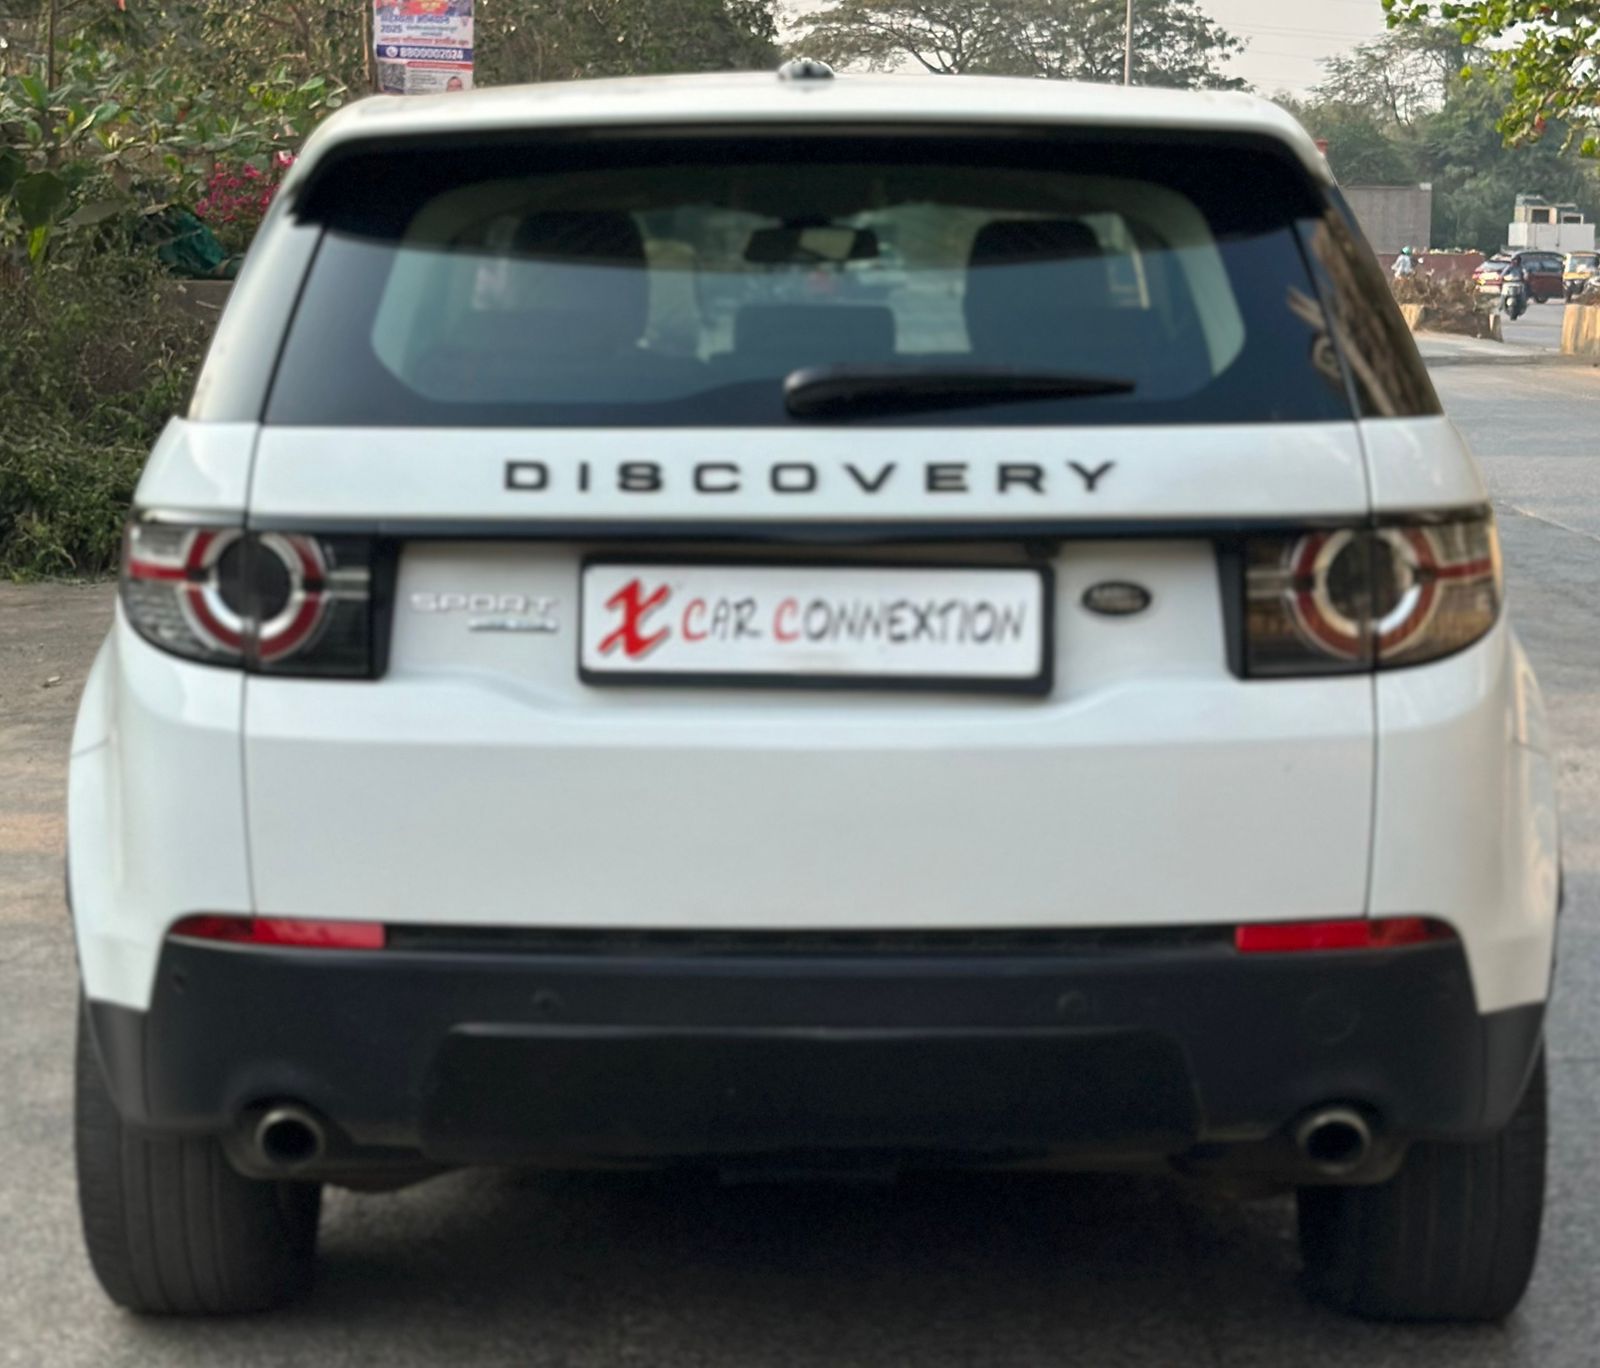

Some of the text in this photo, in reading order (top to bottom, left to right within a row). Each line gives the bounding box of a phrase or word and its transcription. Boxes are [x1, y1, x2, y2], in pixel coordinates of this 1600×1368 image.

[503, 460, 1118, 494] DISCOVERY
[682, 599, 762, 642] CAR
[773, 598, 1026, 644] CONNEXTION
